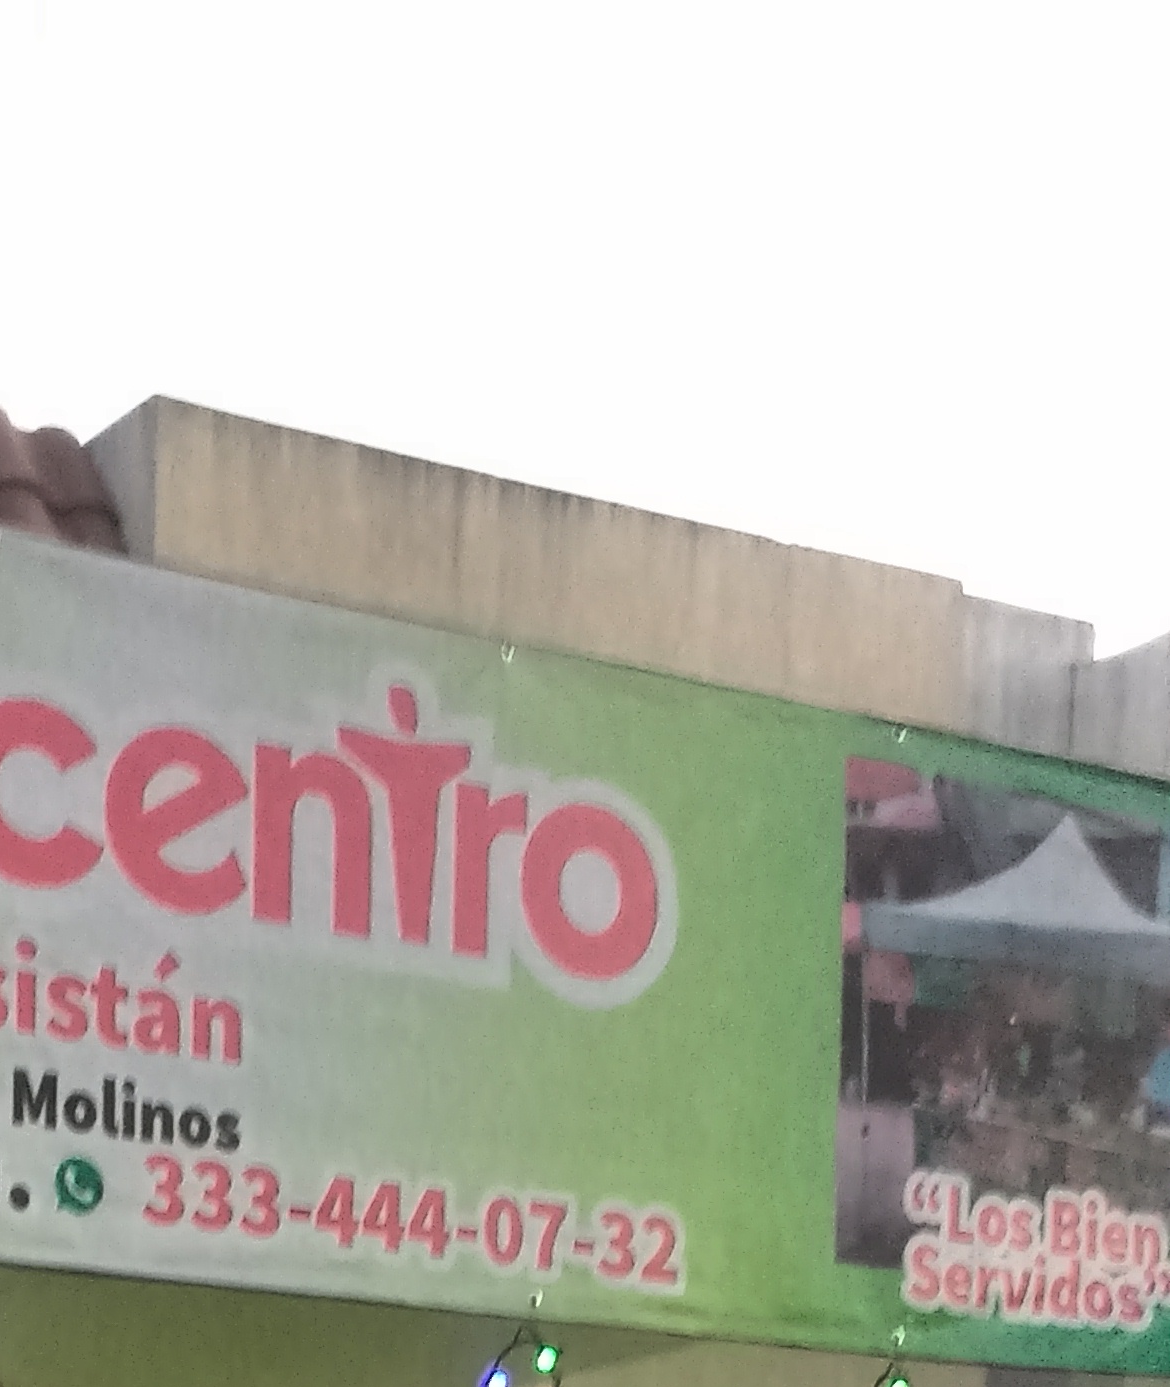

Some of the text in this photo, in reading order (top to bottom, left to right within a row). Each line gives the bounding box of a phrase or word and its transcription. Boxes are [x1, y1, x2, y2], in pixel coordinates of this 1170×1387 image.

[12, 1068, 241, 1153] Molinos
[142, 1154, 679, 1286] 333-444-07-32
[1050, 1200, 1160, 1268] Bien
